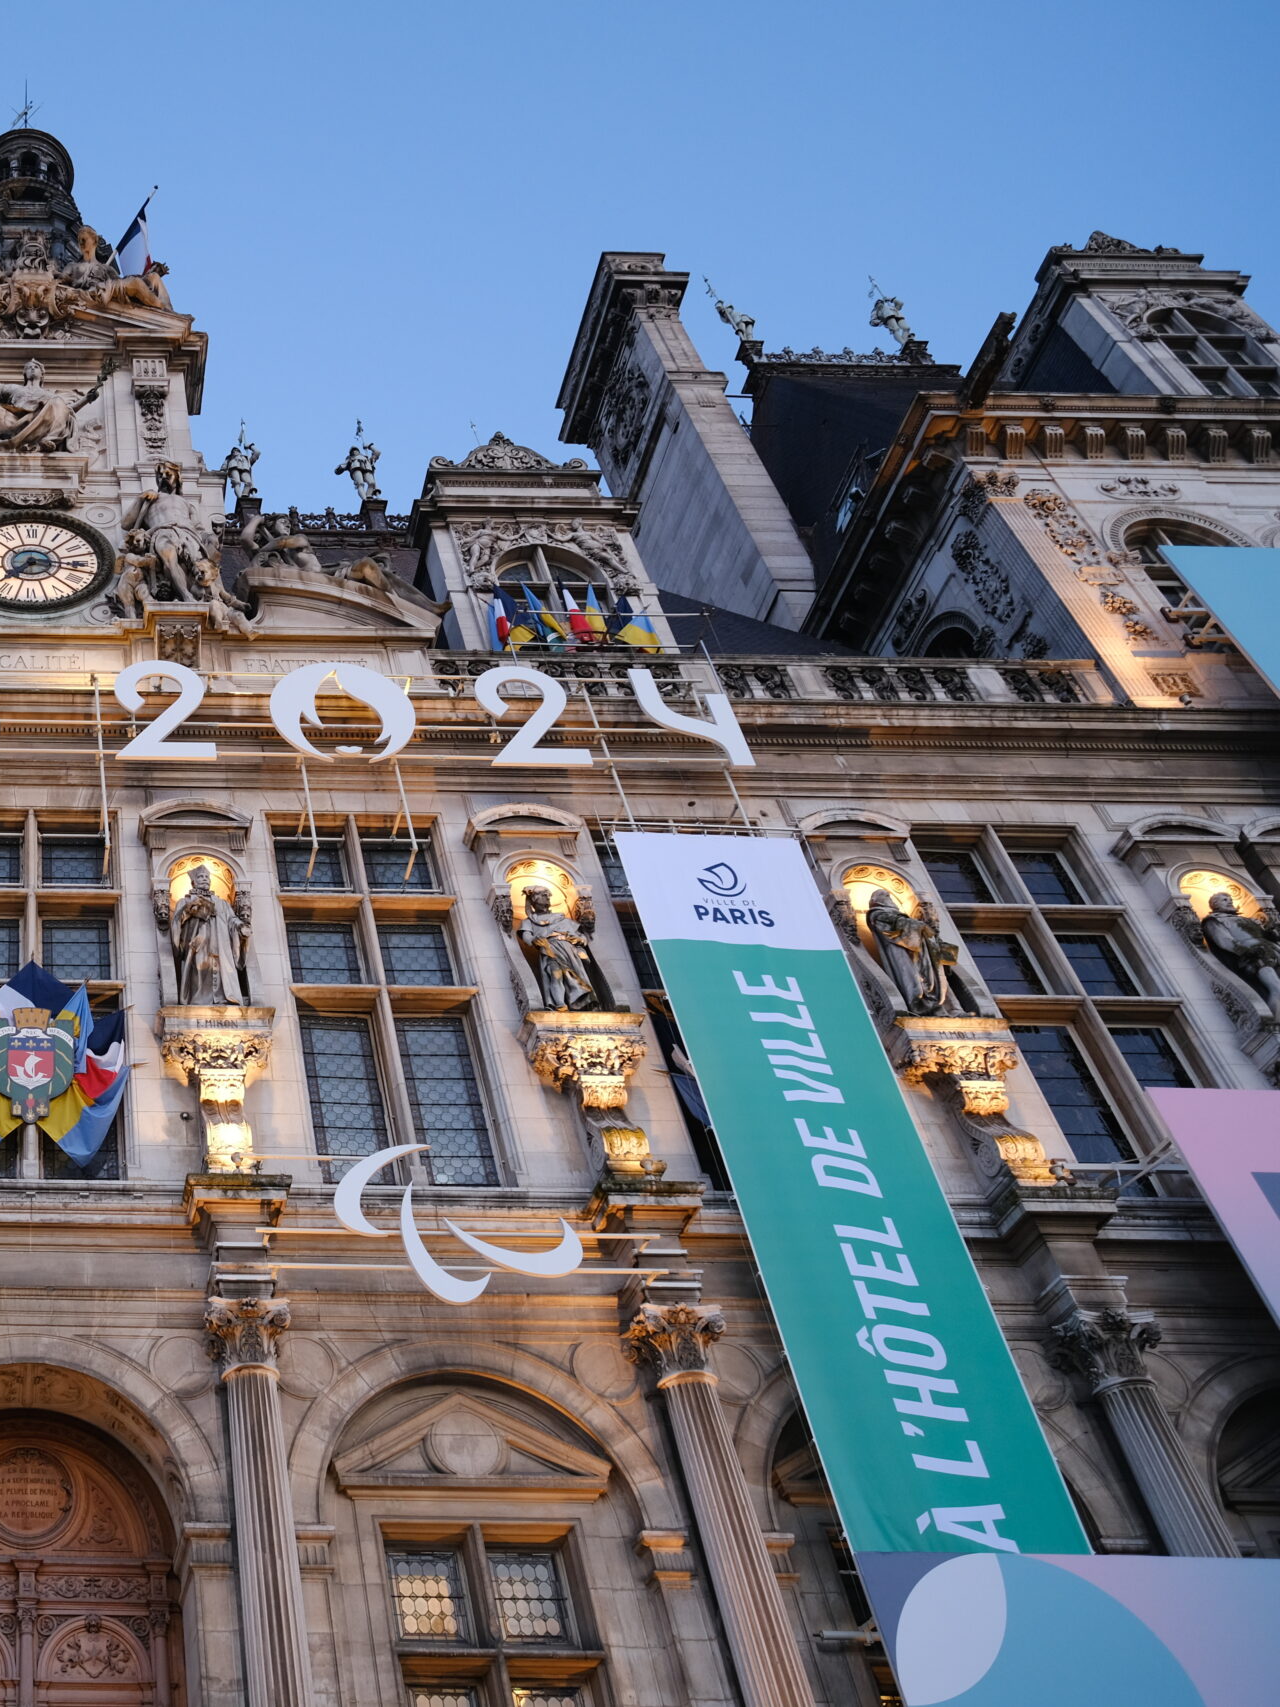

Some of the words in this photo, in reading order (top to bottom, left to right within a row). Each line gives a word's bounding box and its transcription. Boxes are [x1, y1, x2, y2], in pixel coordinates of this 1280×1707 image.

[26, 529, 37, 538] XII
[114, 660, 757, 767] 2024
[693, 905, 776, 928] PARIS
[702, 897, 737, 906] VILLE
[732, 970, 846, 1105] VILLE
[793, 1118, 883, 1199] DE
[915, 1503, 1022, 1555] À
